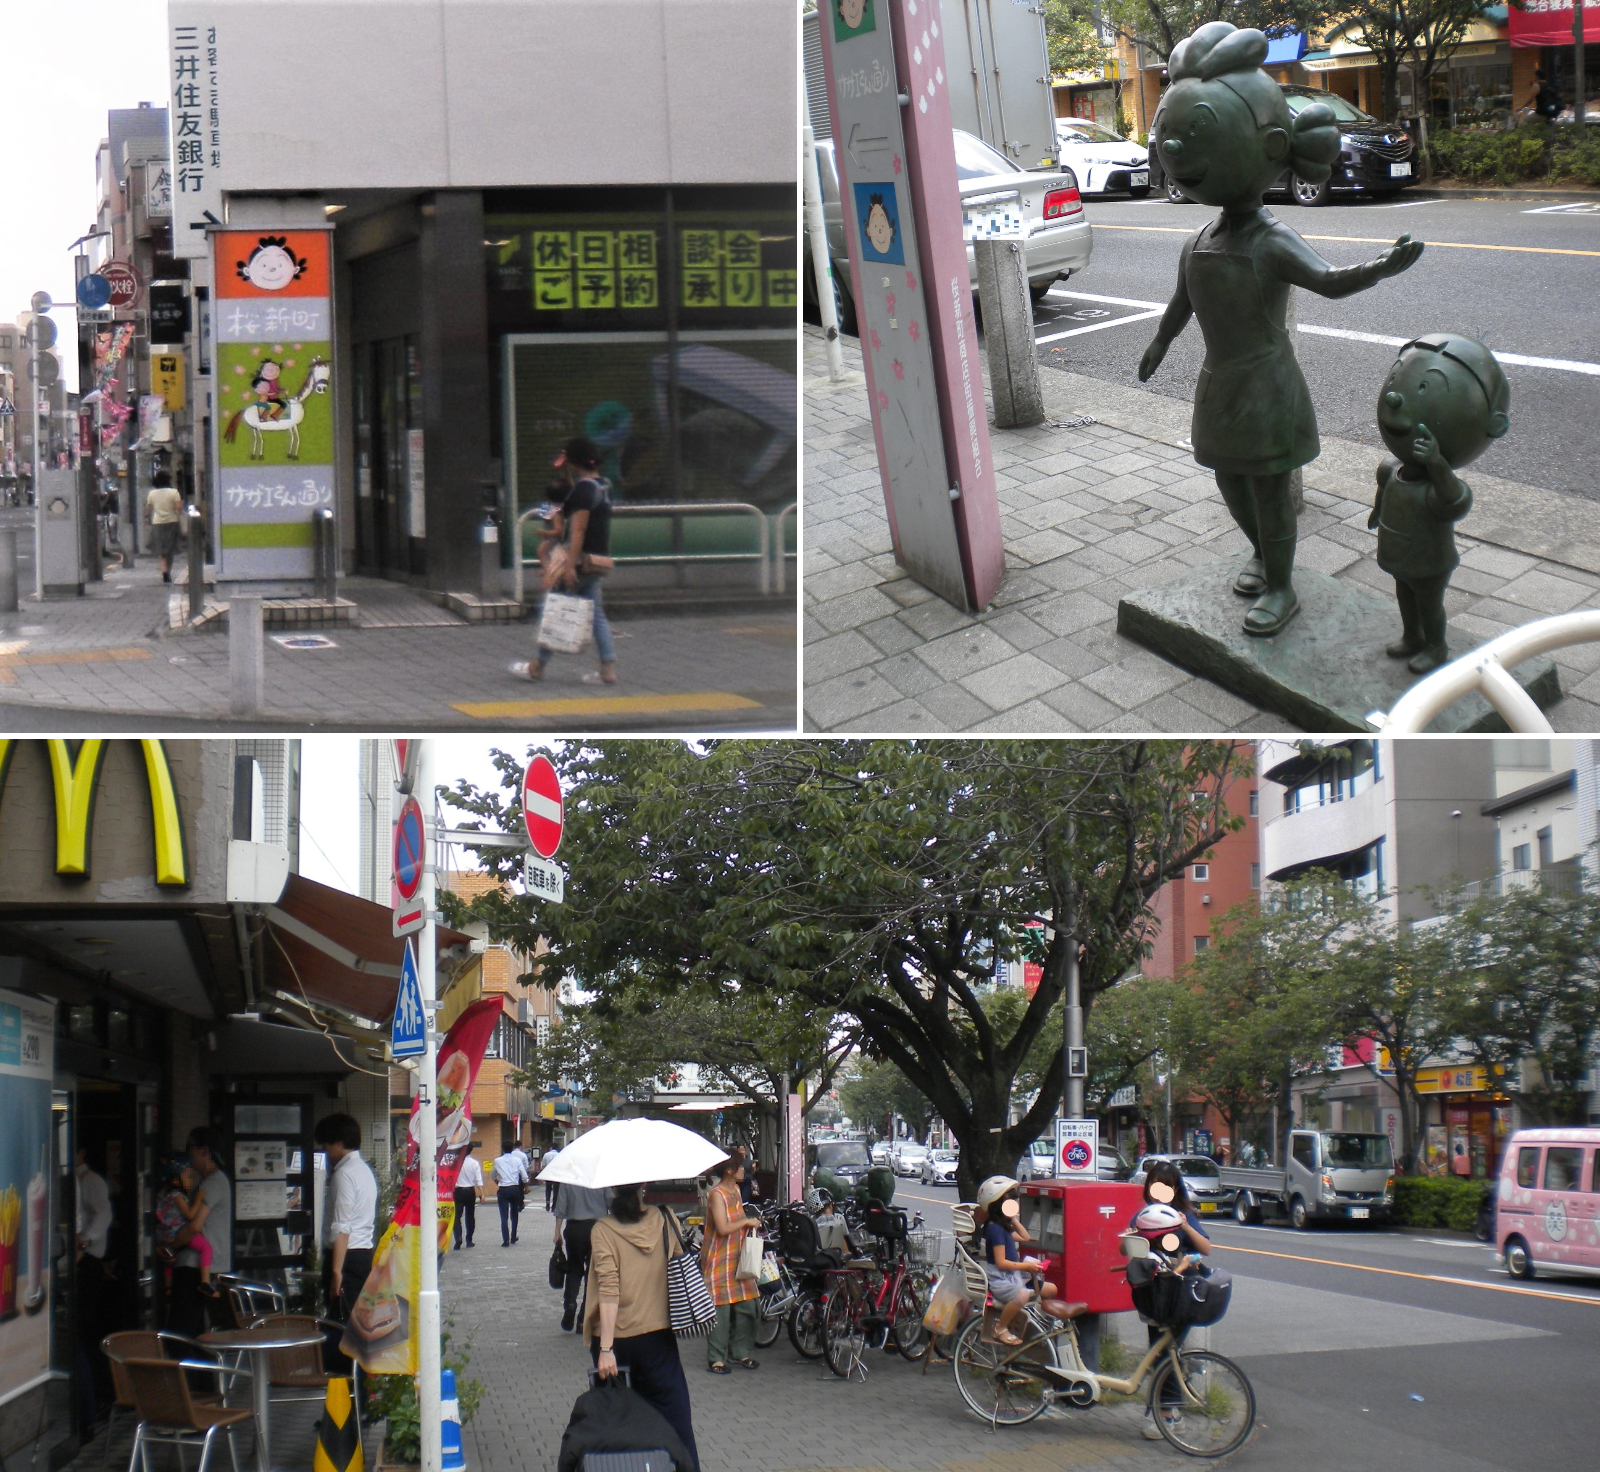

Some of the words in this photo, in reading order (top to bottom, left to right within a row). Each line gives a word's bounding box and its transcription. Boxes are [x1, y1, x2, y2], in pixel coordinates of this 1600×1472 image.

[837, 59, 890, 99] サザエさん通り
[175, 27, 204, 192] 三井住友銀行
[227, 307, 320, 336] 桜新町
[227, 479, 331, 508] サザエさん通り
[528, 865, 560, 895] 自転車を除く
[1455, 1071, 1473, 1086] 松屋
